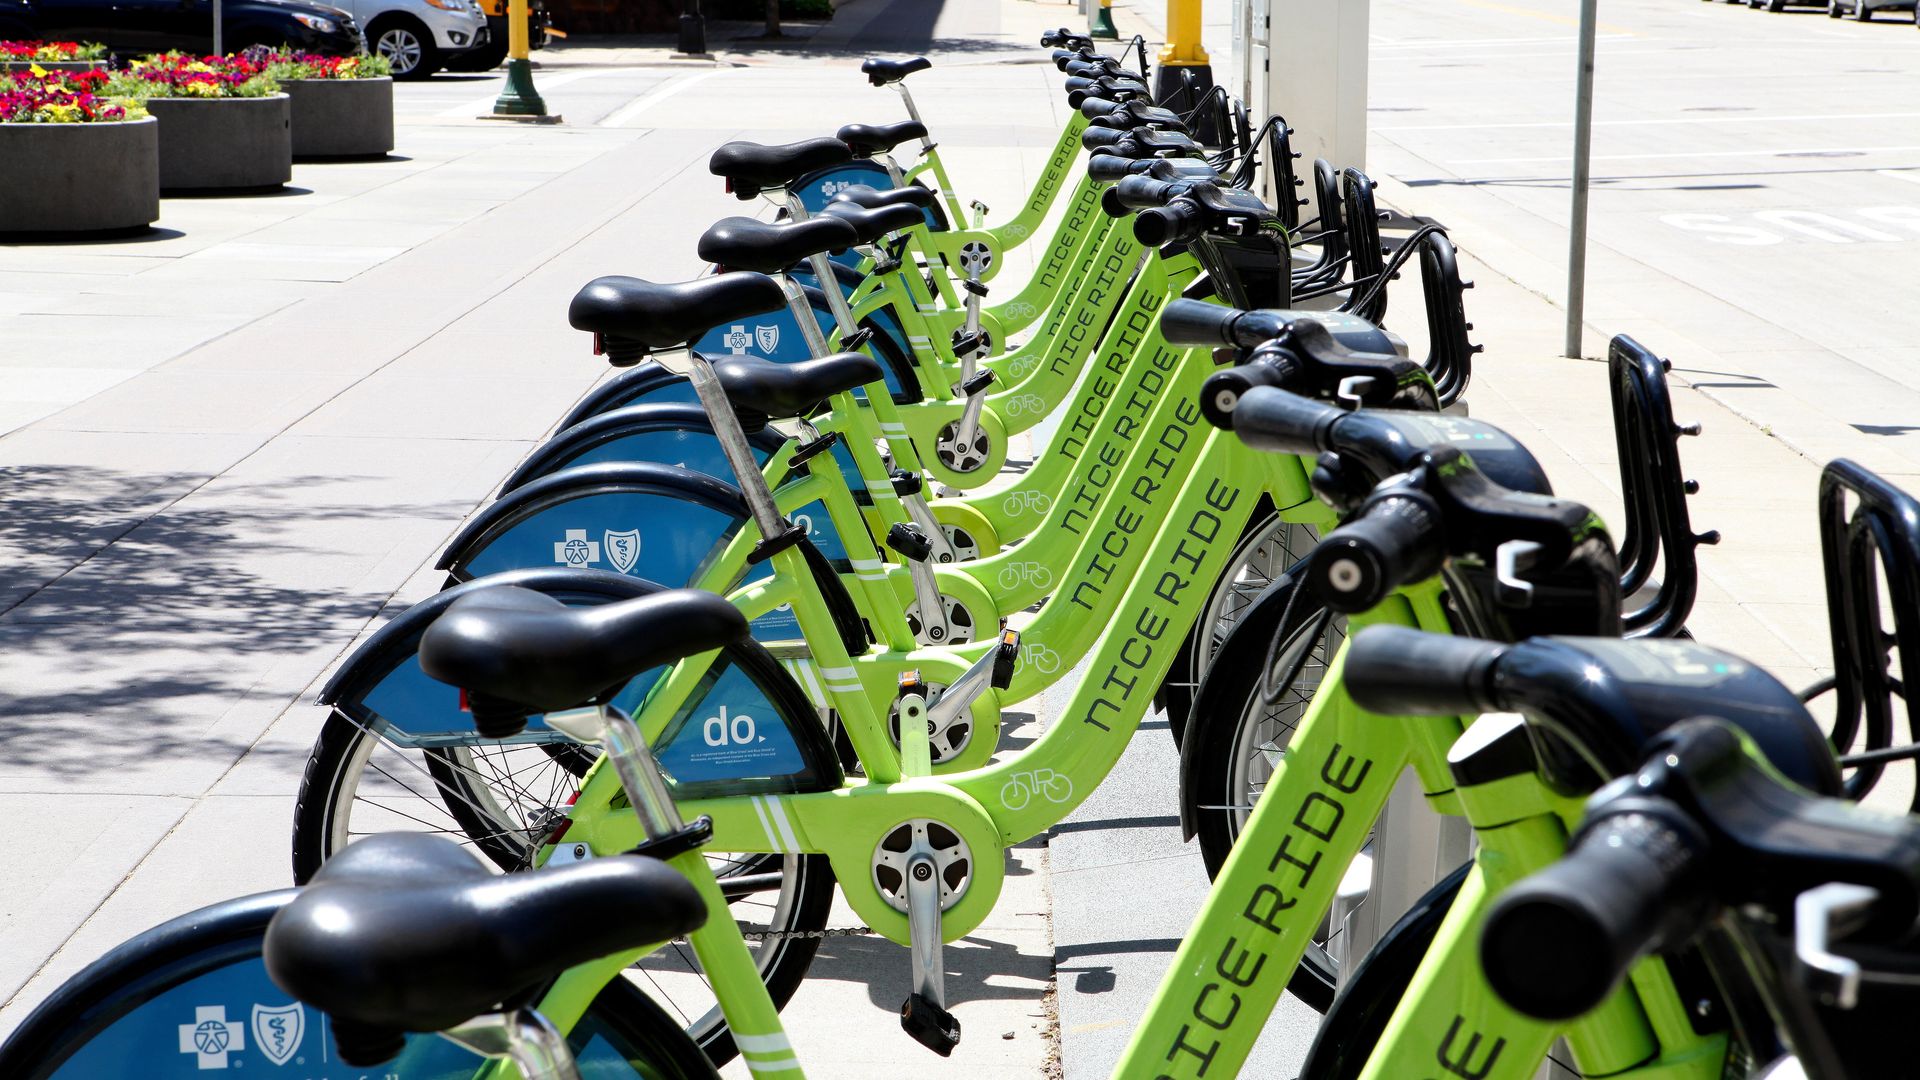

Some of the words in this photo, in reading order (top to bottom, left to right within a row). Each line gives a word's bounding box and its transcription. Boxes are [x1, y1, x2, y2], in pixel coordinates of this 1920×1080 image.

[1031, 172, 1059, 212] NICE
[1054, 125, 1082, 169] RIDE
[1039, 232, 1076, 288] NICE
[1068, 180, 1103, 232] RIDE
[1050, 307, 1095, 376] NICE
[1087, 237, 1132, 306] RIDE
[1059, 375, 1116, 460] NICE
[1105, 289, 1163, 375] RIDE
[1060, 441, 1125, 534] NICE
[1113, 346, 1178, 441] RIDE
[1070, 504, 1143, 610] NICE
[1131, 396, 1202, 504] RIDE
[1084, 607, 1170, 732] NICE
[1153, 477, 1240, 606] RIDE
[1242, 742, 1374, 935] RIDE
[1154, 936, 1268, 1080] ICE
